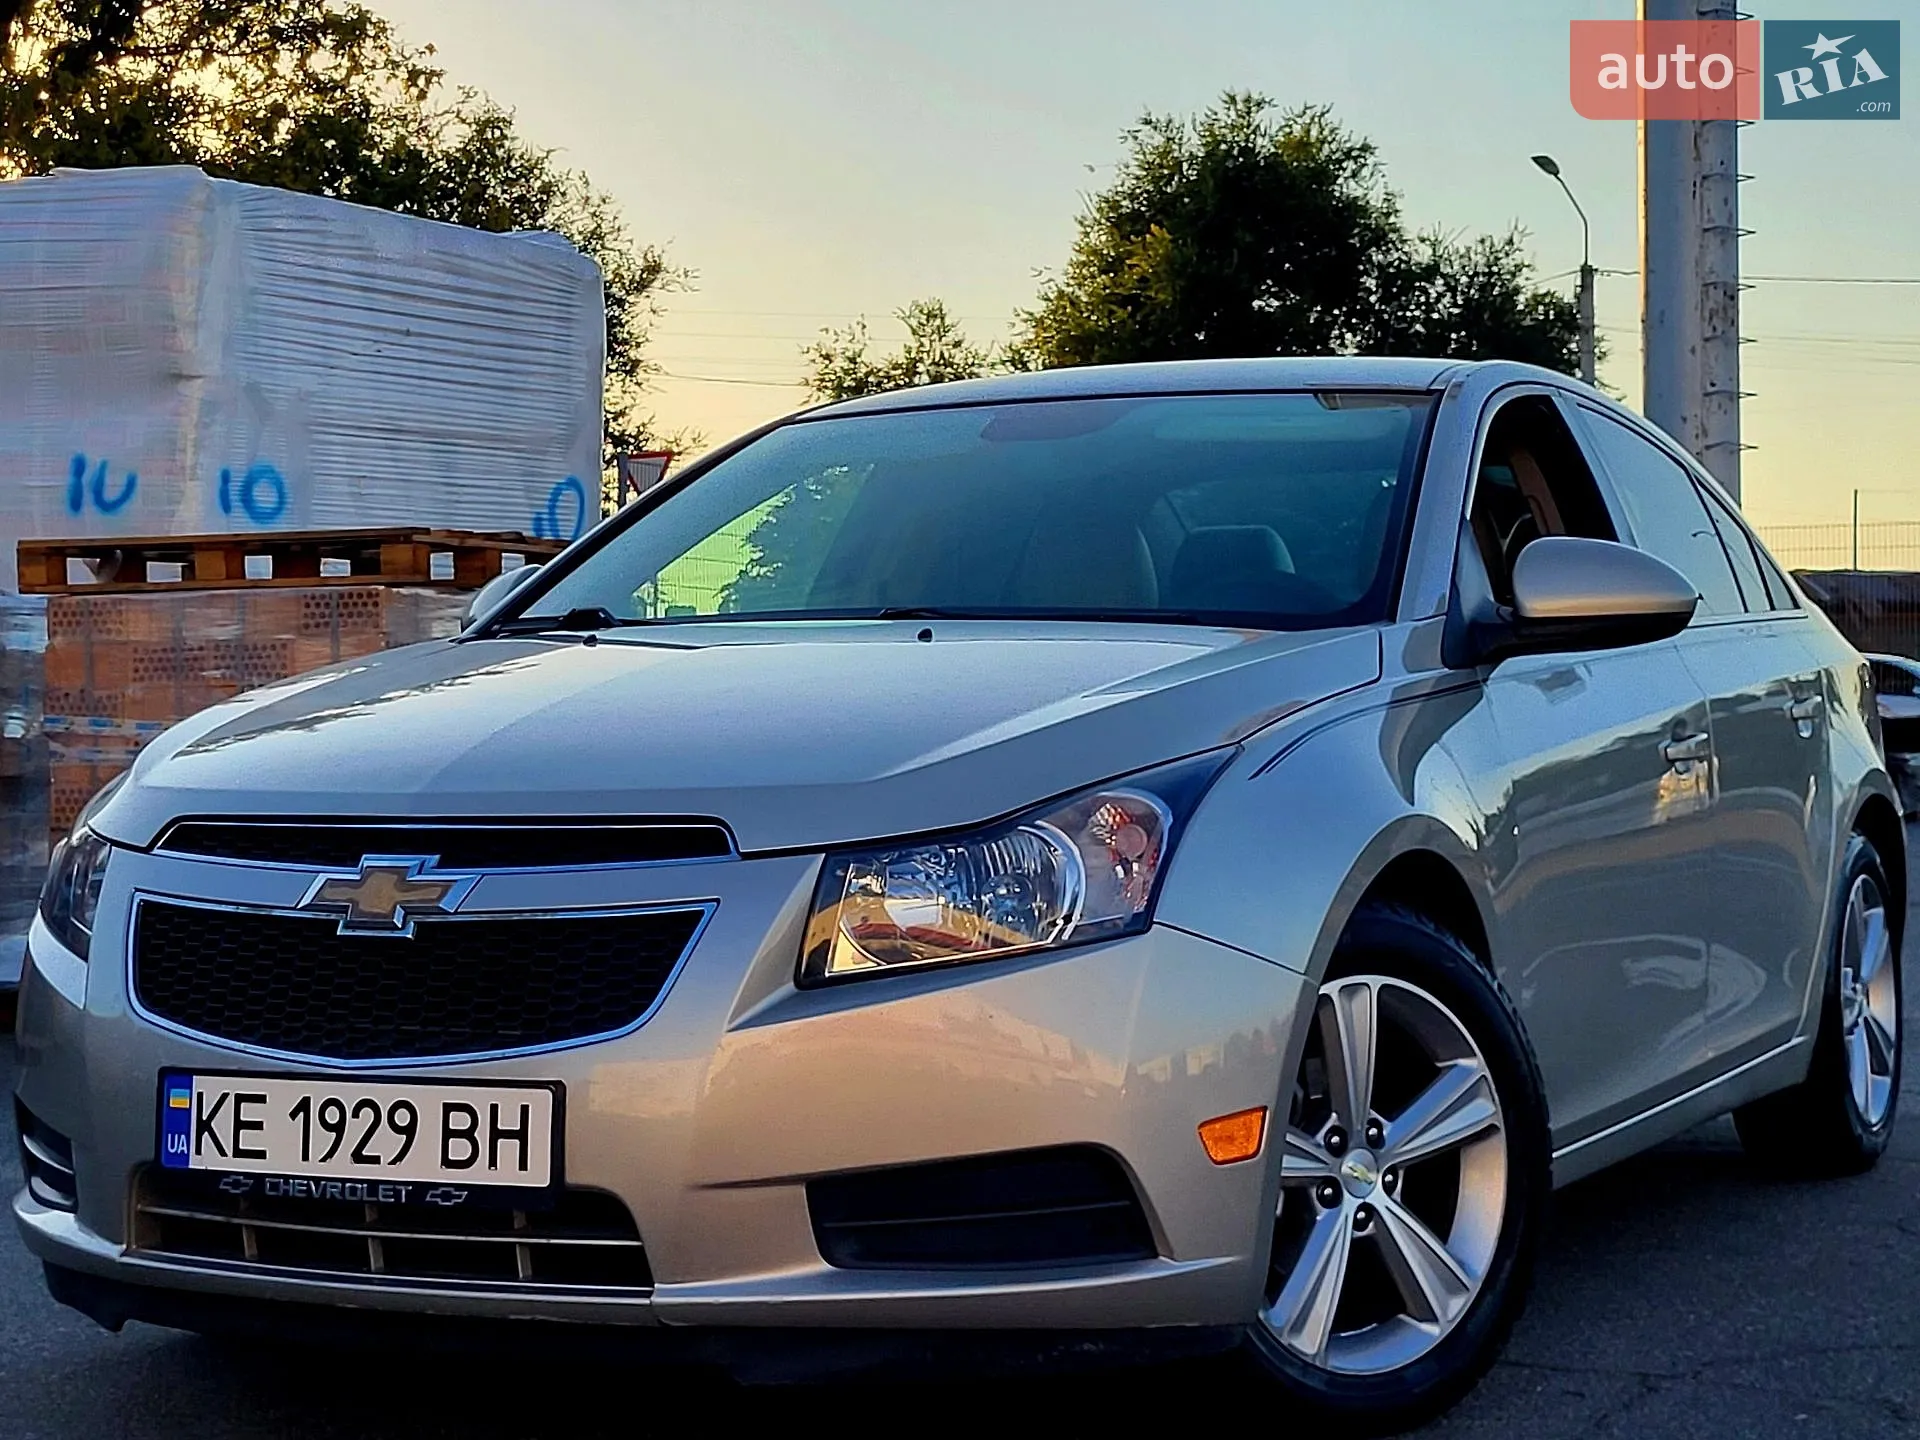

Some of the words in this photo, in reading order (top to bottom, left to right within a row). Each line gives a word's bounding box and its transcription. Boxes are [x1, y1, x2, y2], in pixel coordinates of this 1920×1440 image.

[218, 463, 288, 524] 10
[167, 1133, 188, 1155] UA
[195, 1091, 268, 1160] KE
[288, 1096, 419, 1166] 1929
[440, 1102, 530, 1171] BH
[264, 1178, 412, 1203] CHEVROLET
